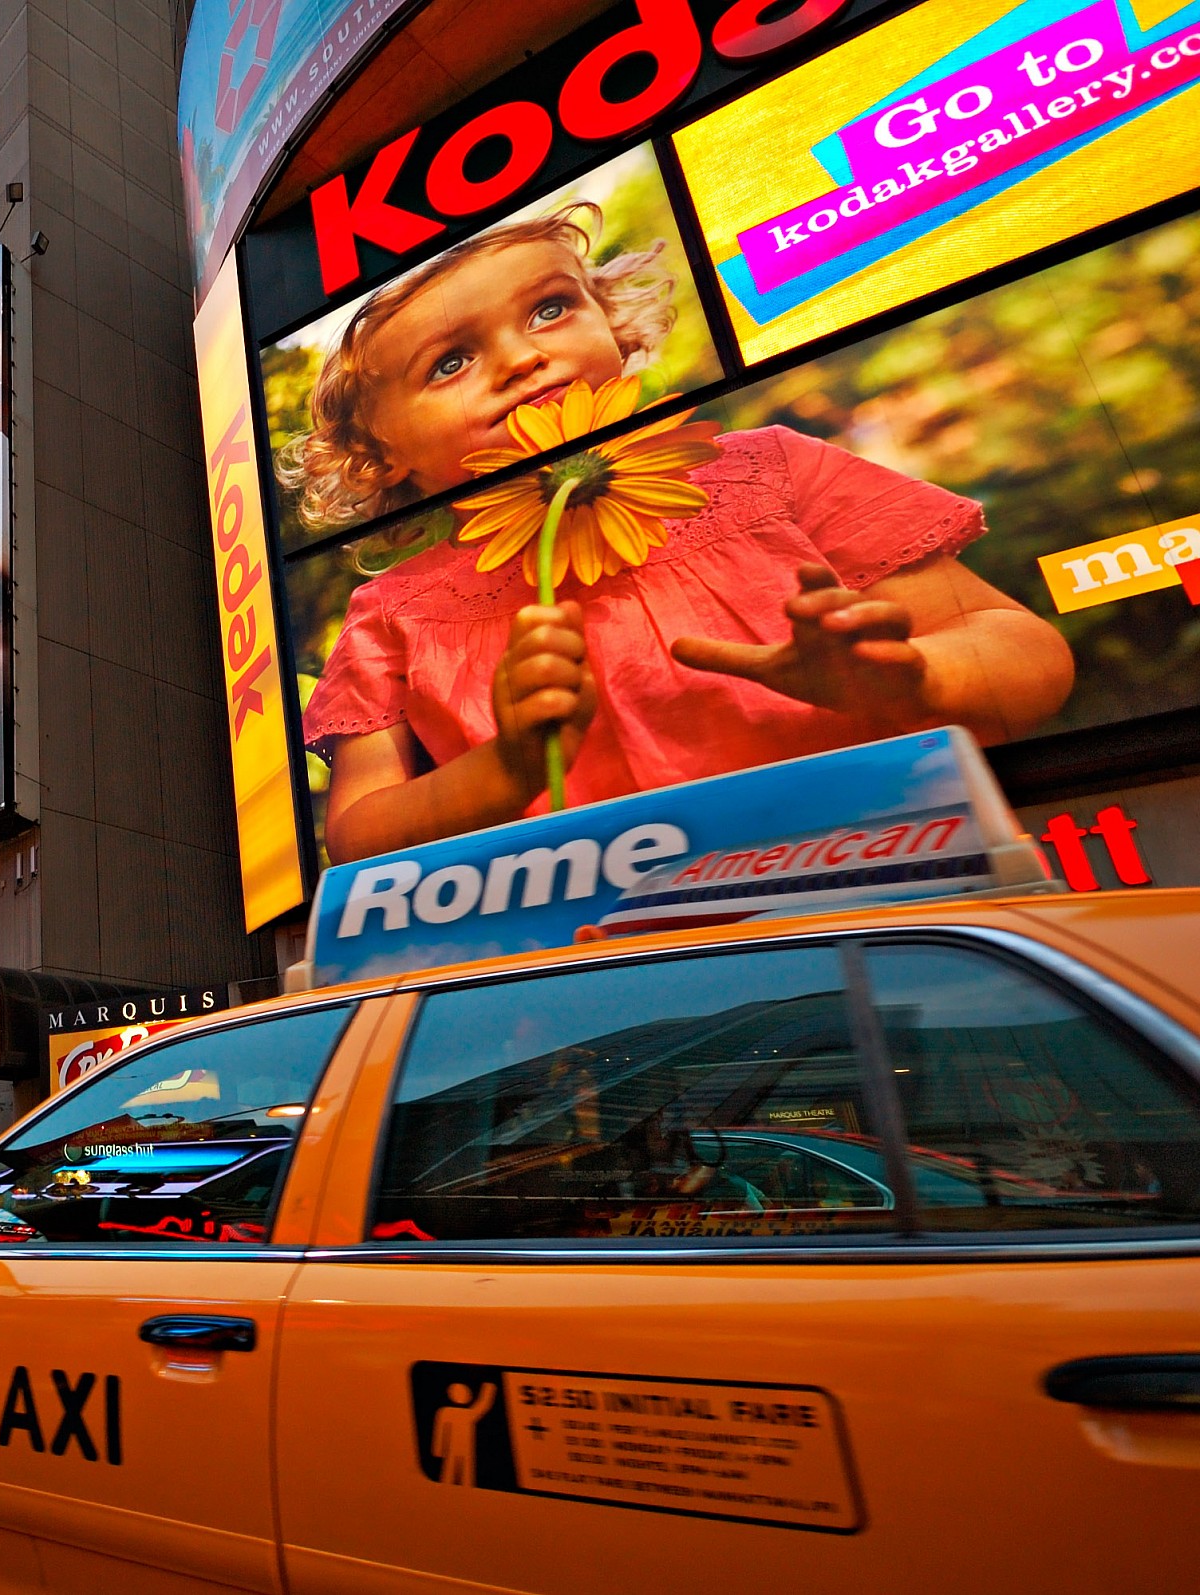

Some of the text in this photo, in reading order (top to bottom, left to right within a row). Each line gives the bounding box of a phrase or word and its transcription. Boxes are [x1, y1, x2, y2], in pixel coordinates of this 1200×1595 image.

[309, 55, 343, 99] GERMANY
[352, 11, 382, 44] UNITED
[874, 38, 1104, 149] Go to
[337, 822, 688, 939] Rome
[675, 816, 963, 885] American
[1034, 804, 1152, 892] tt
[49, 990, 215, 1029] MARQUIS
[769, 1107, 836, 1119] MARQUIS THEATRE
[84, 1142, 154, 1158] sunglass hut
[604, 1391, 719, 1421] INITIAL
[731, 1400, 820, 1430] FARE
